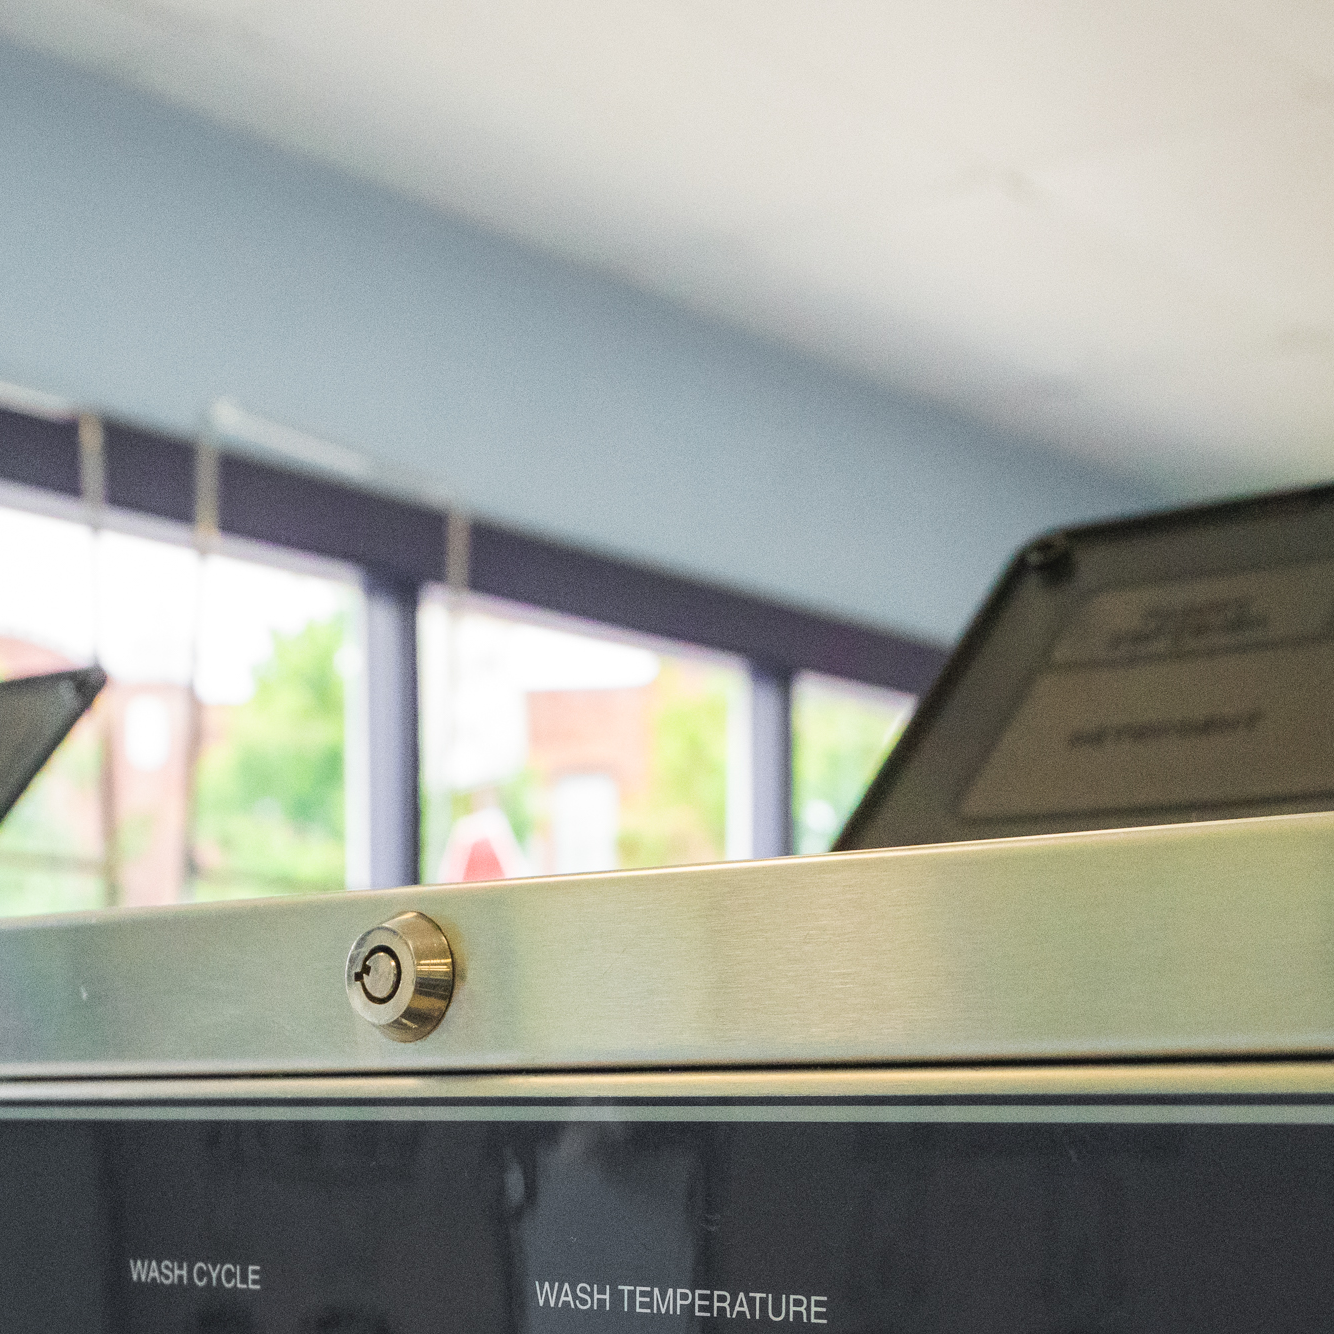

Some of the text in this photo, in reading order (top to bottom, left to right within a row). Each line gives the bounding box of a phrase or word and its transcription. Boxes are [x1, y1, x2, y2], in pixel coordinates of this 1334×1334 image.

[130, 1259, 262, 1290] WASH CYCLE
[535, 1280, 829, 1324] WASH TEMPERATURE
